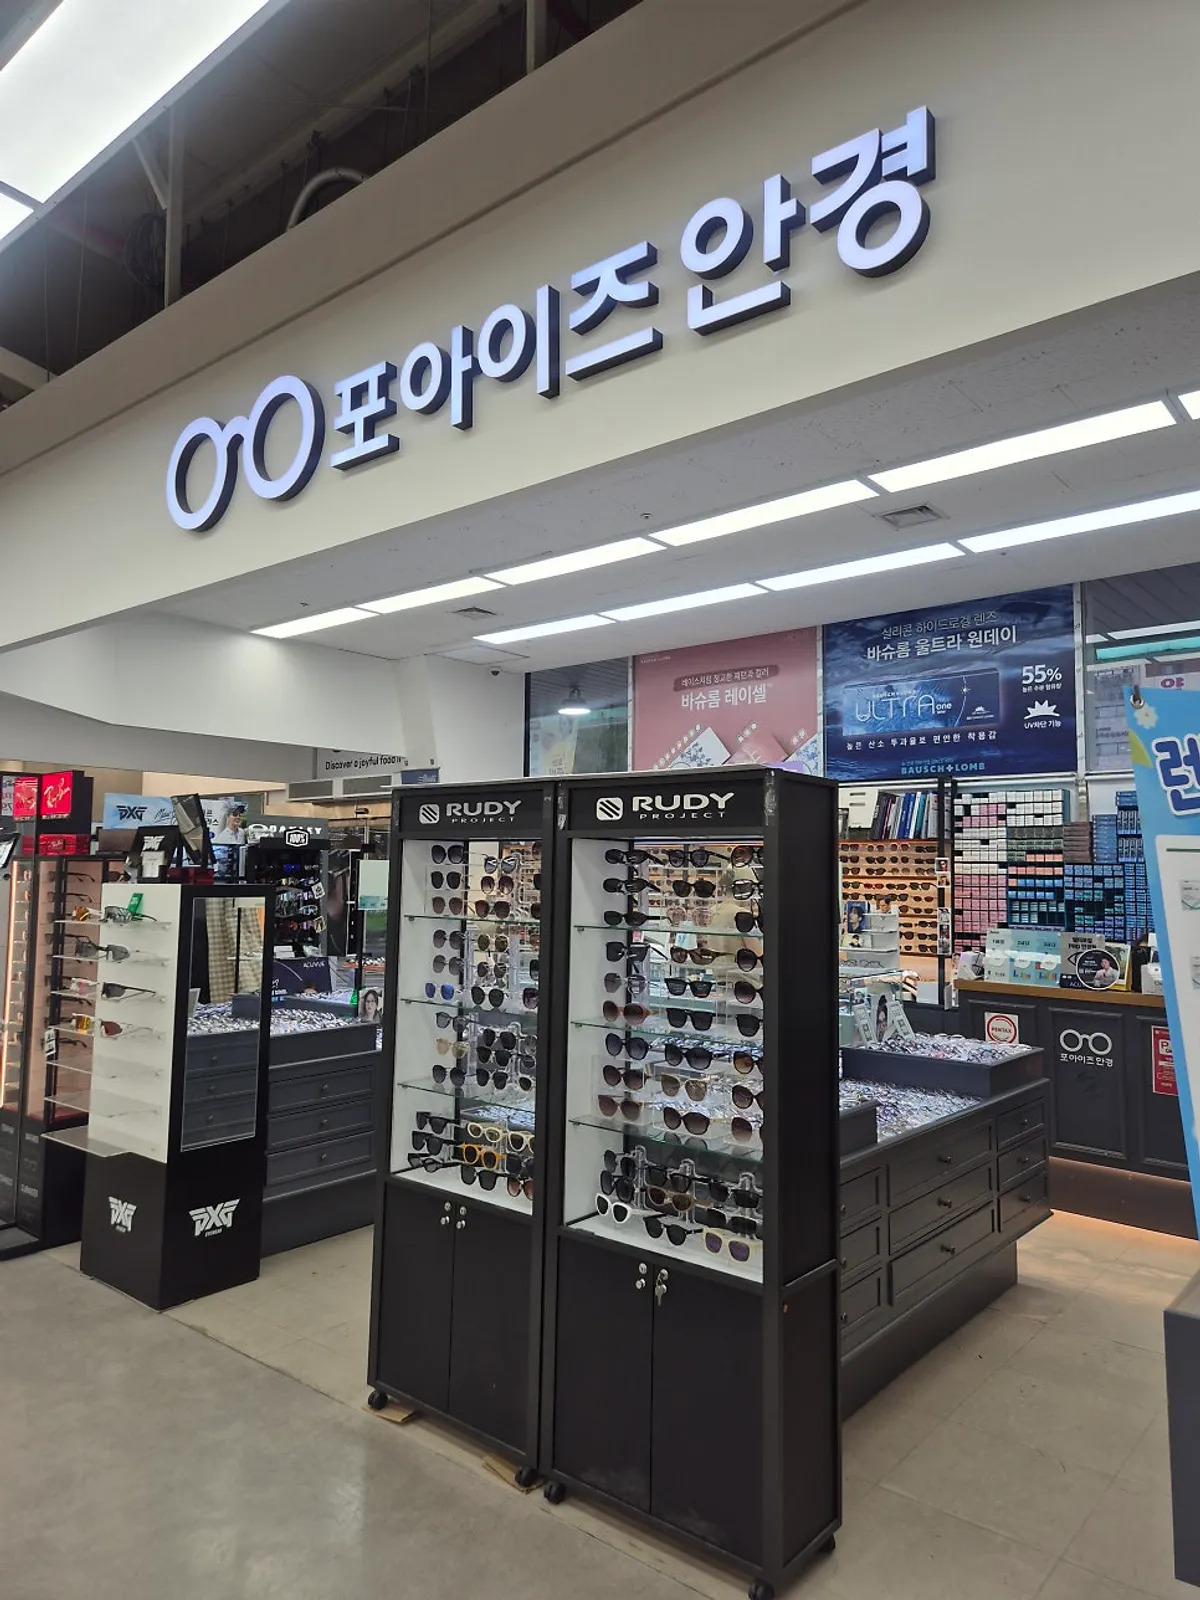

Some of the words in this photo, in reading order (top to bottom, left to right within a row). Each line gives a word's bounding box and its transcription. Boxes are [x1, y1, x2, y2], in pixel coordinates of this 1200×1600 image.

[331, 241, 663, 471] 포아이즈
[680, 105, 936, 336] 안경
[973, 611, 999, 624] 렌즈
[867, 641, 911, 662] 바슈롬
[915, 633, 962, 656] 울트라
[967, 625, 1018, 650] 원데이
[1022, 664, 1063, 684] 55%
[681, 689, 721, 711] 바슈롬
[724, 682, 767, 706] 레이셀
[446, 800, 522, 816] RUDY
[632, 792, 735, 812] RUDY
[116, 805, 148, 821] PXG
[451, 817, 516, 825] PROJECT
[639, 812, 726, 820] PROJECT
[1060, 1053, 1095, 1065] 포아이즈
[1095, 1057, 1113, 1067] 안경
[188, 1198, 241, 1236] PXG
